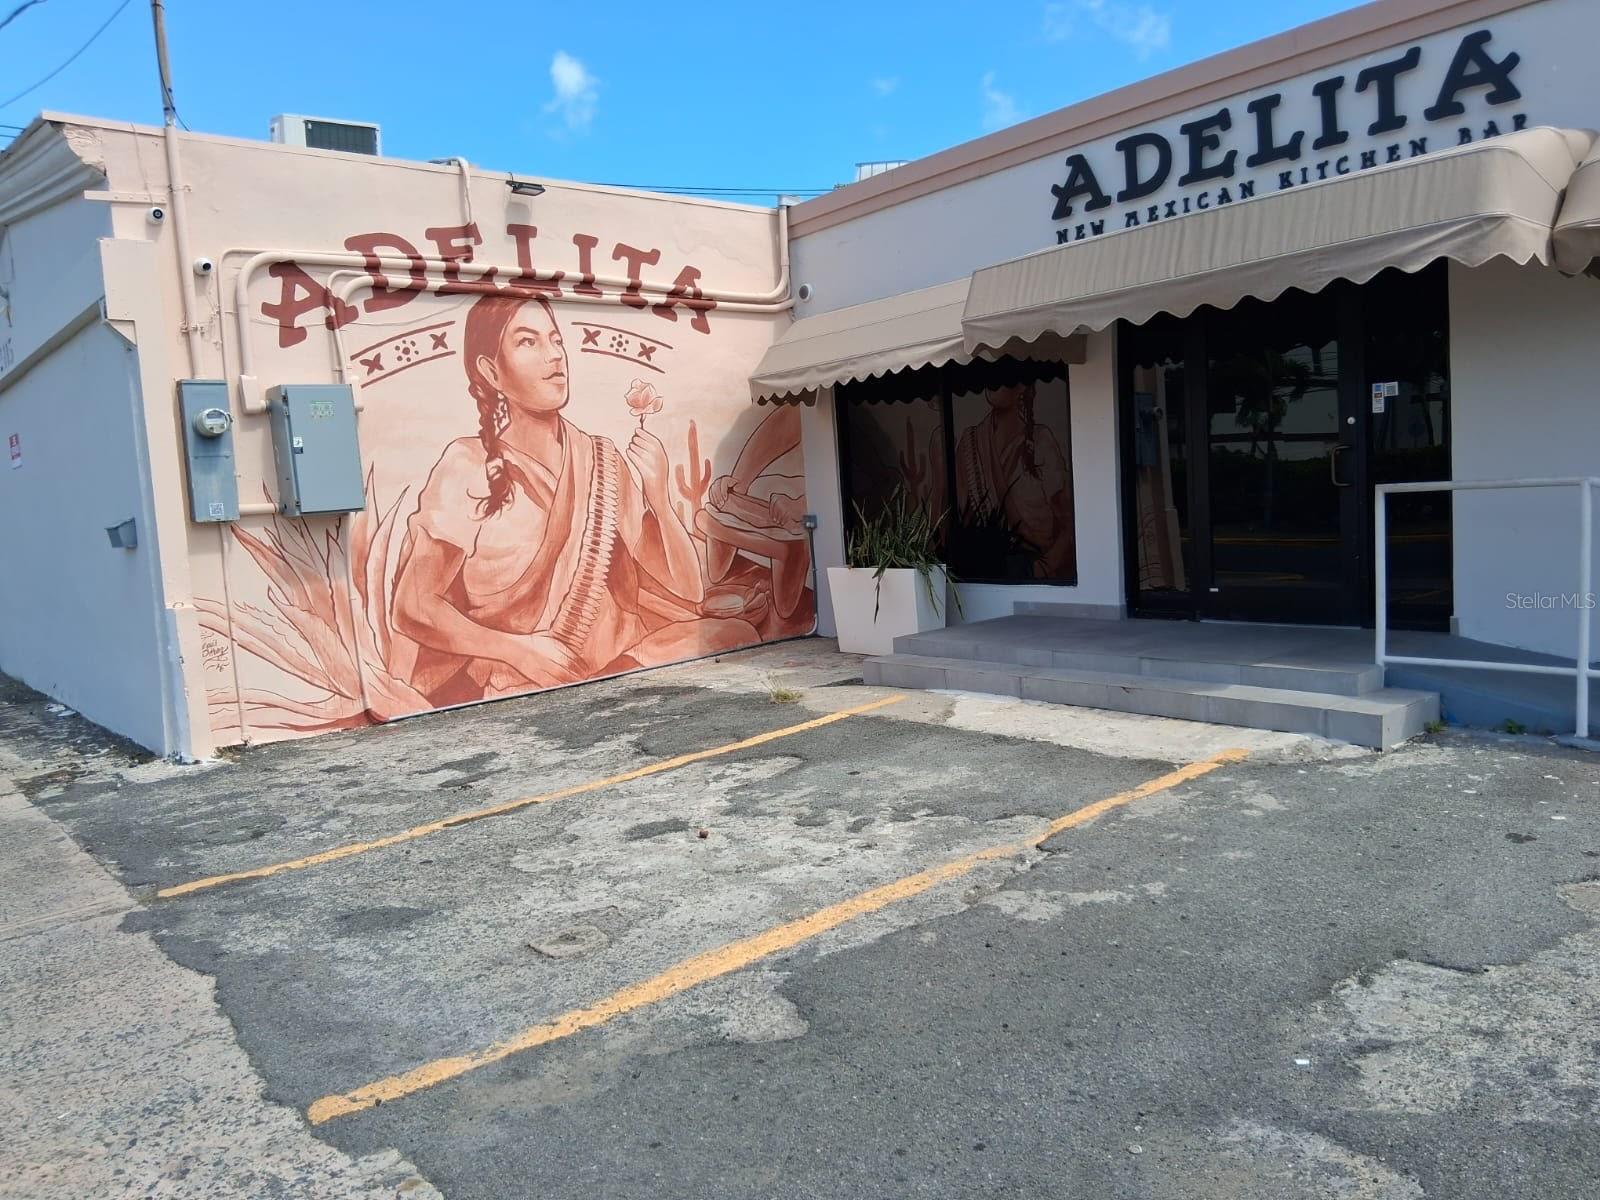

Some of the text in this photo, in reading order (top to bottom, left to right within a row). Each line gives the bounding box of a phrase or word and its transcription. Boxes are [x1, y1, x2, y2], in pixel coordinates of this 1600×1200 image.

[1051, 29, 1521, 220] ADELITA
[1056, 220, 1104, 244] NEW
[1125, 180, 1254, 227] MEXICAN
[1278, 137, 1427, 189] KITCHEN
[261, 223, 717, 348] ADELITA
